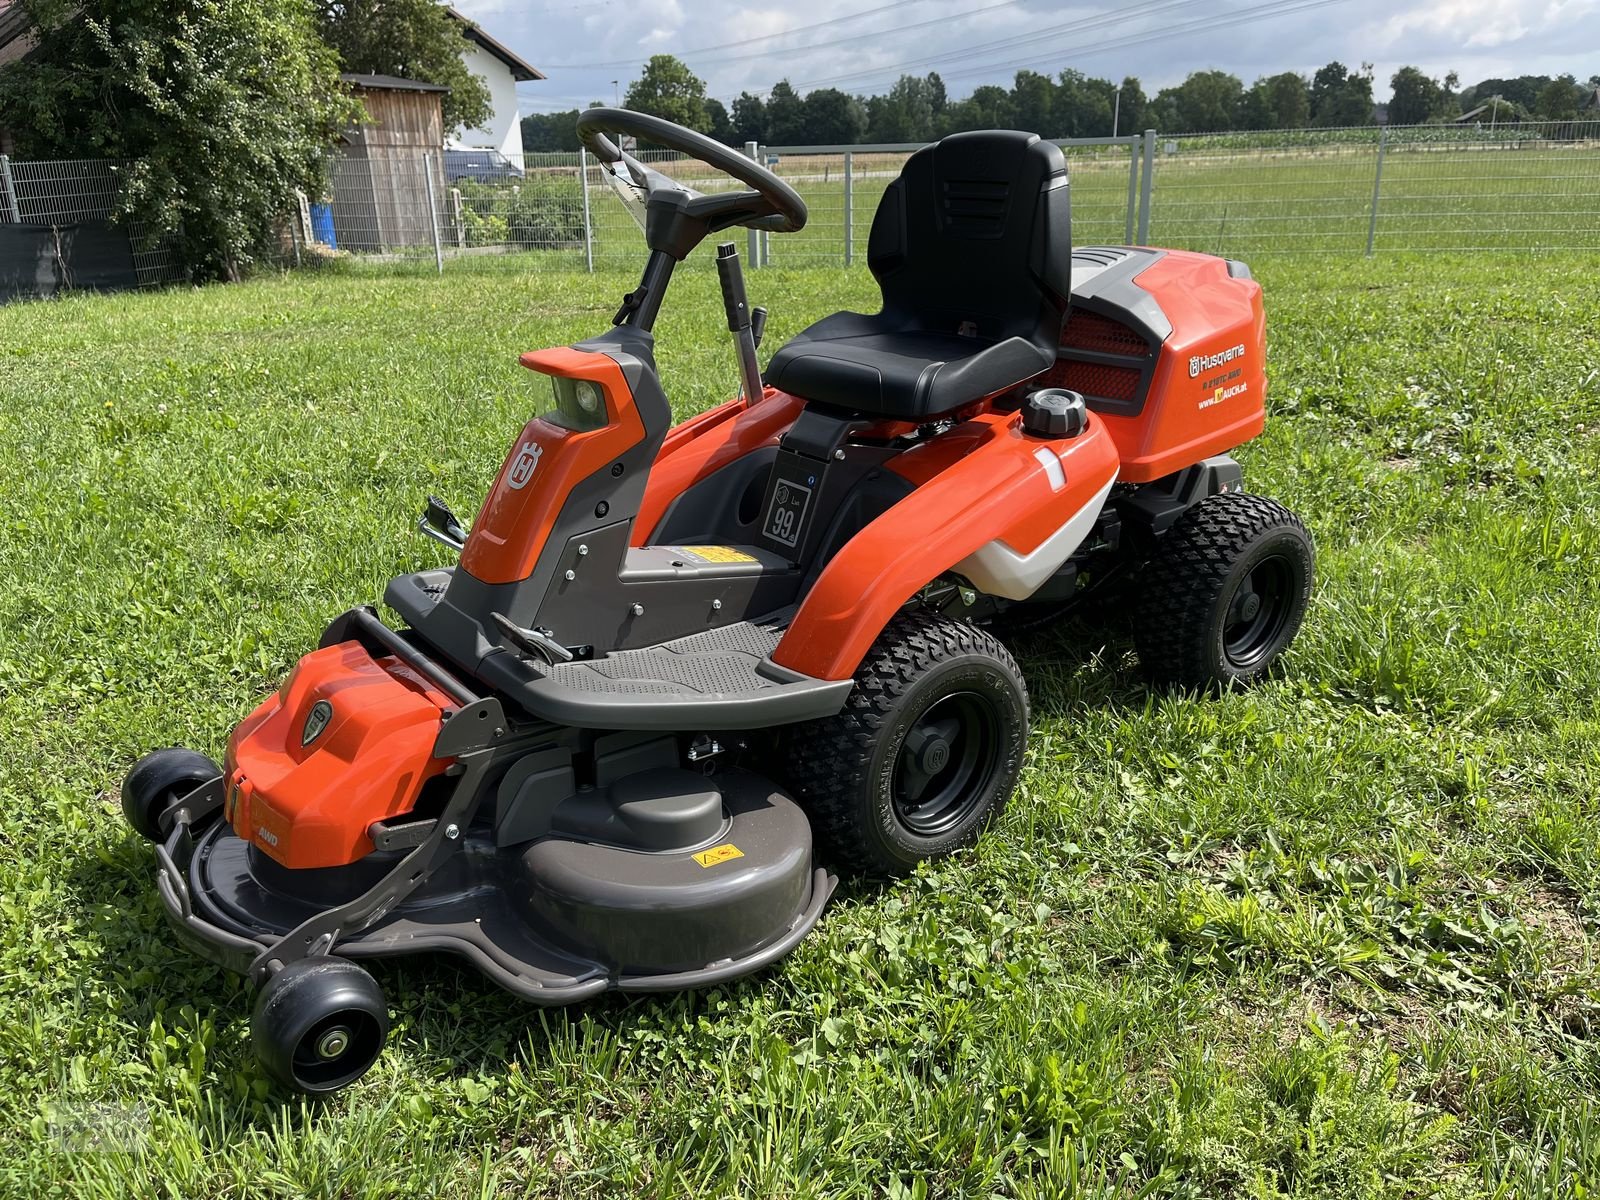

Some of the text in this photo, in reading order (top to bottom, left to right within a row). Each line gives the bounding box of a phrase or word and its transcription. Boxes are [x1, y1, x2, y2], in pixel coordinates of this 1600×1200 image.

[1200, 344, 1245, 371] Husqvarna
[772, 507, 794, 538] 99
[259, 826, 278, 847] AWD
